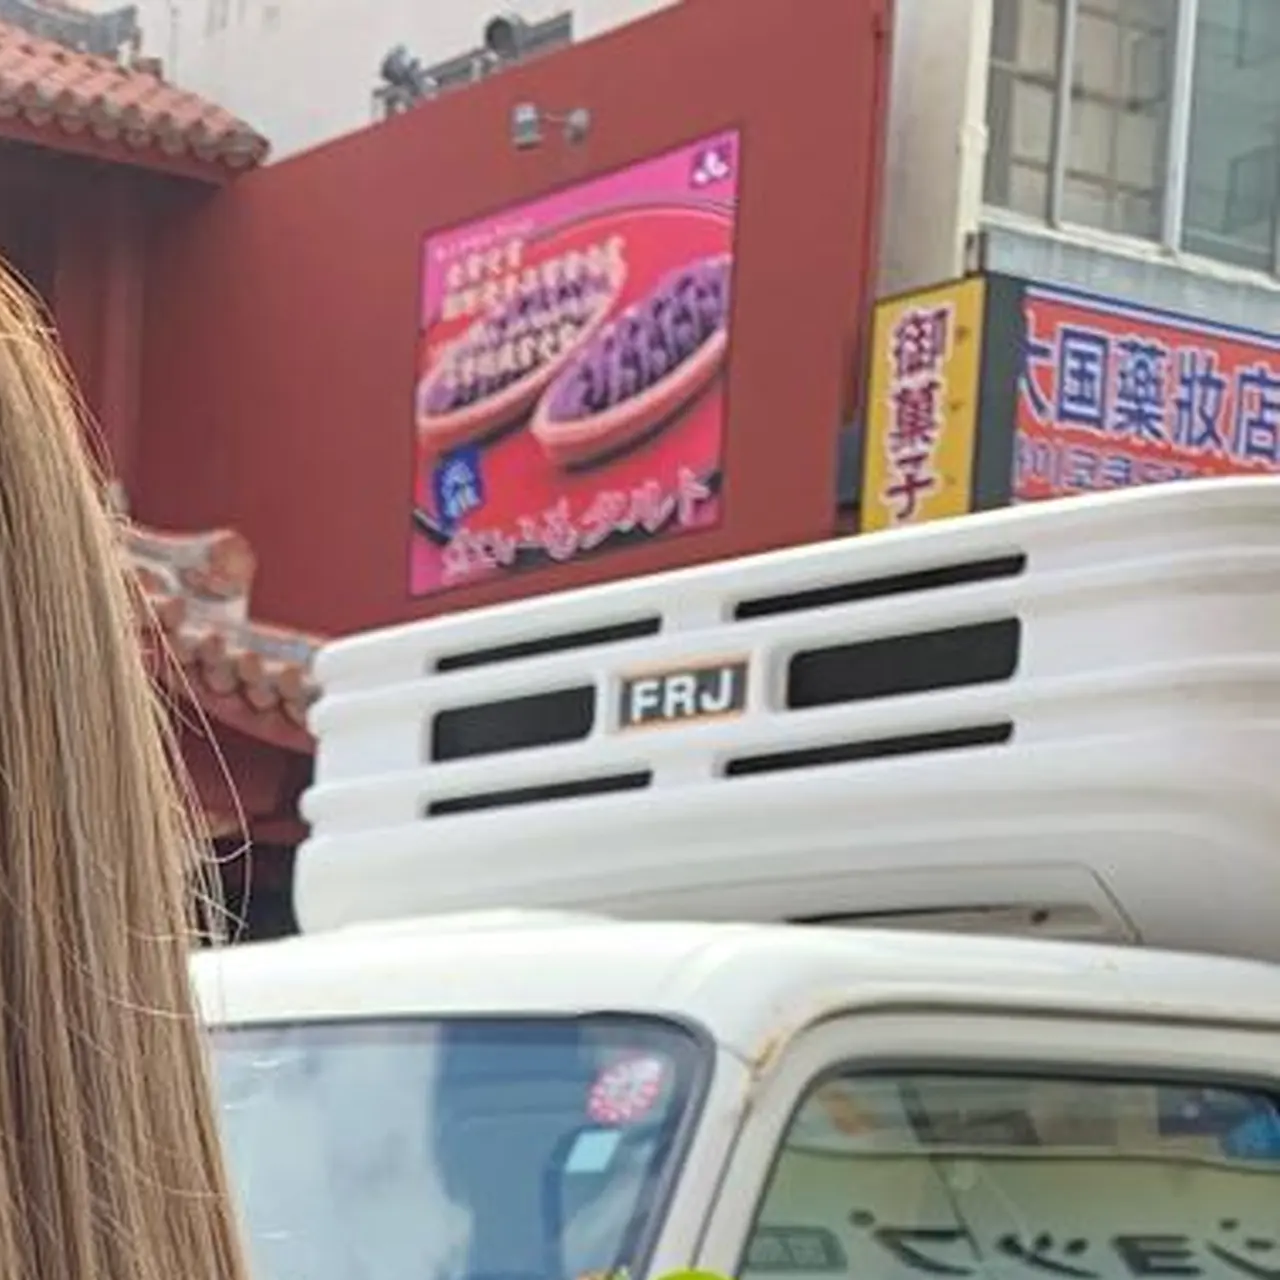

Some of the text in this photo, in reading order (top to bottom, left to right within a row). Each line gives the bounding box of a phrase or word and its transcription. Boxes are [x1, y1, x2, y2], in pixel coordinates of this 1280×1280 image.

[887, 307, 950, 519] 御菓子
[631, 668, 733, 724] FRJ
